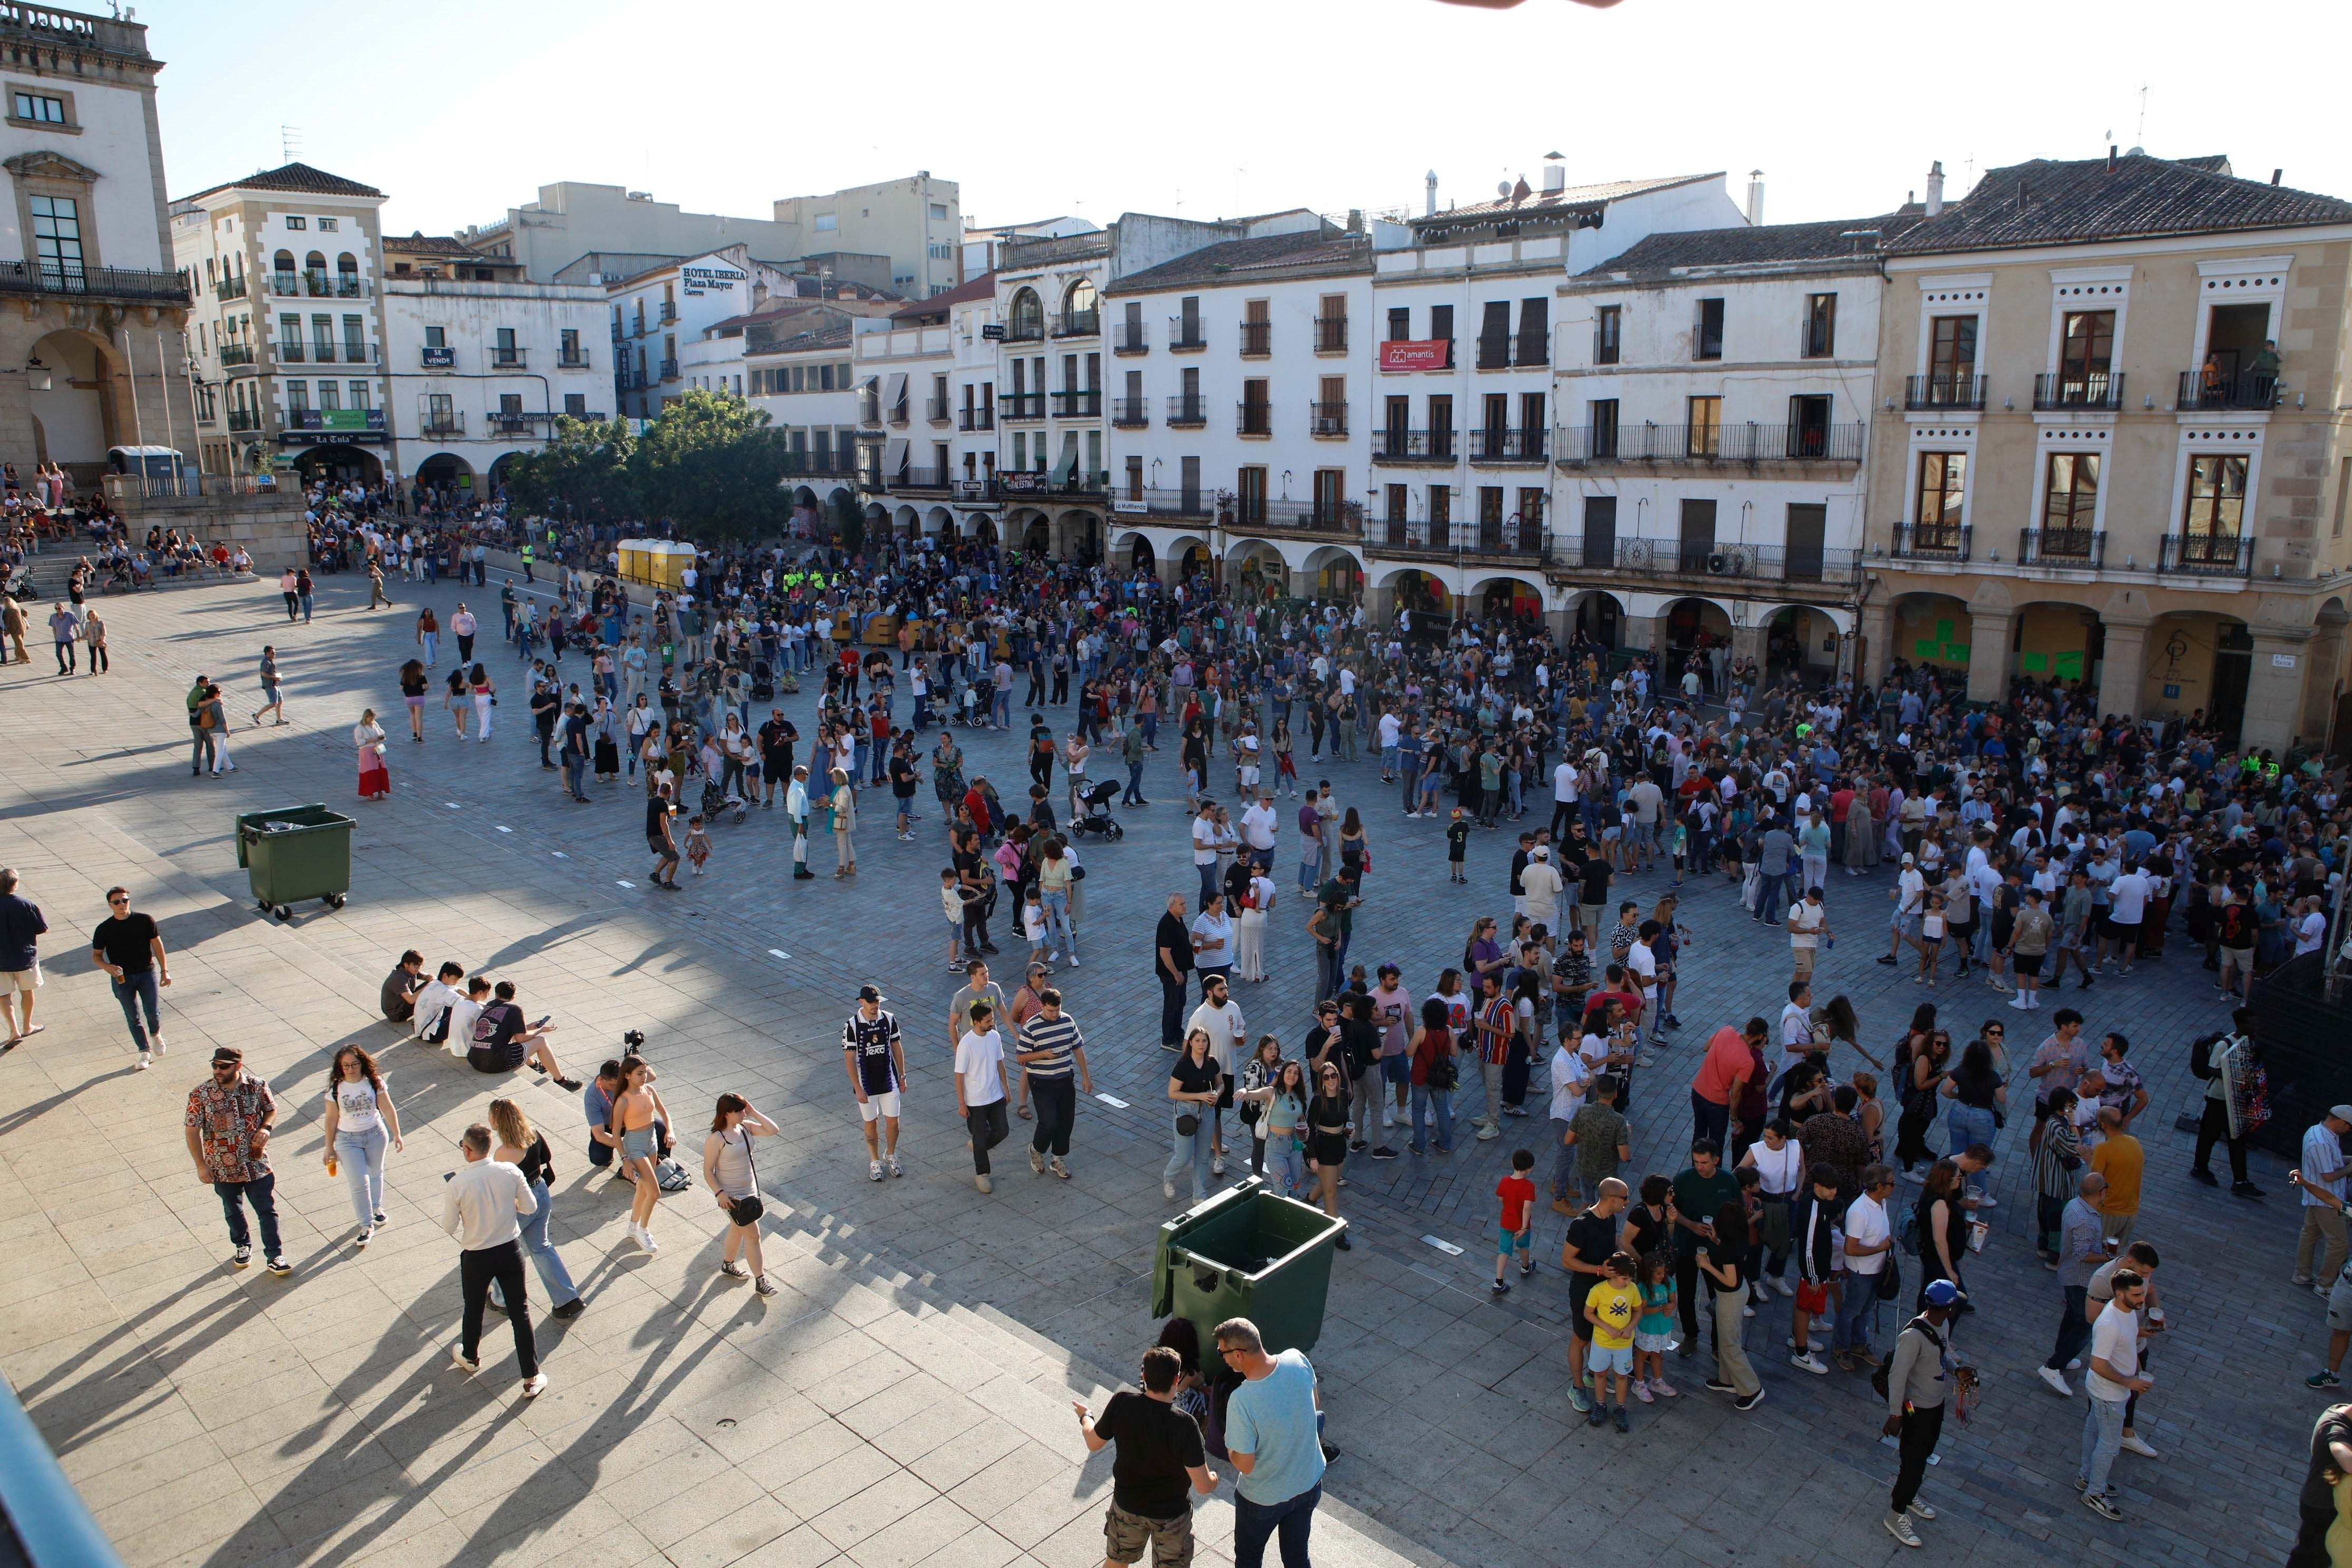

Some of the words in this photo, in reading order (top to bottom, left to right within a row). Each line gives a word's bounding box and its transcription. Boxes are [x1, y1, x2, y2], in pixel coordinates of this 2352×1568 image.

[683, 268, 713, 278] HOTEL
[714, 269, 746, 280] IBERIA
[683, 278, 707, 288] Plaza
[707, 279, 733, 291] Mayor
[1407, 350, 1434, 359] amantis
[1011, 479, 1034, 489] PALESTINA
